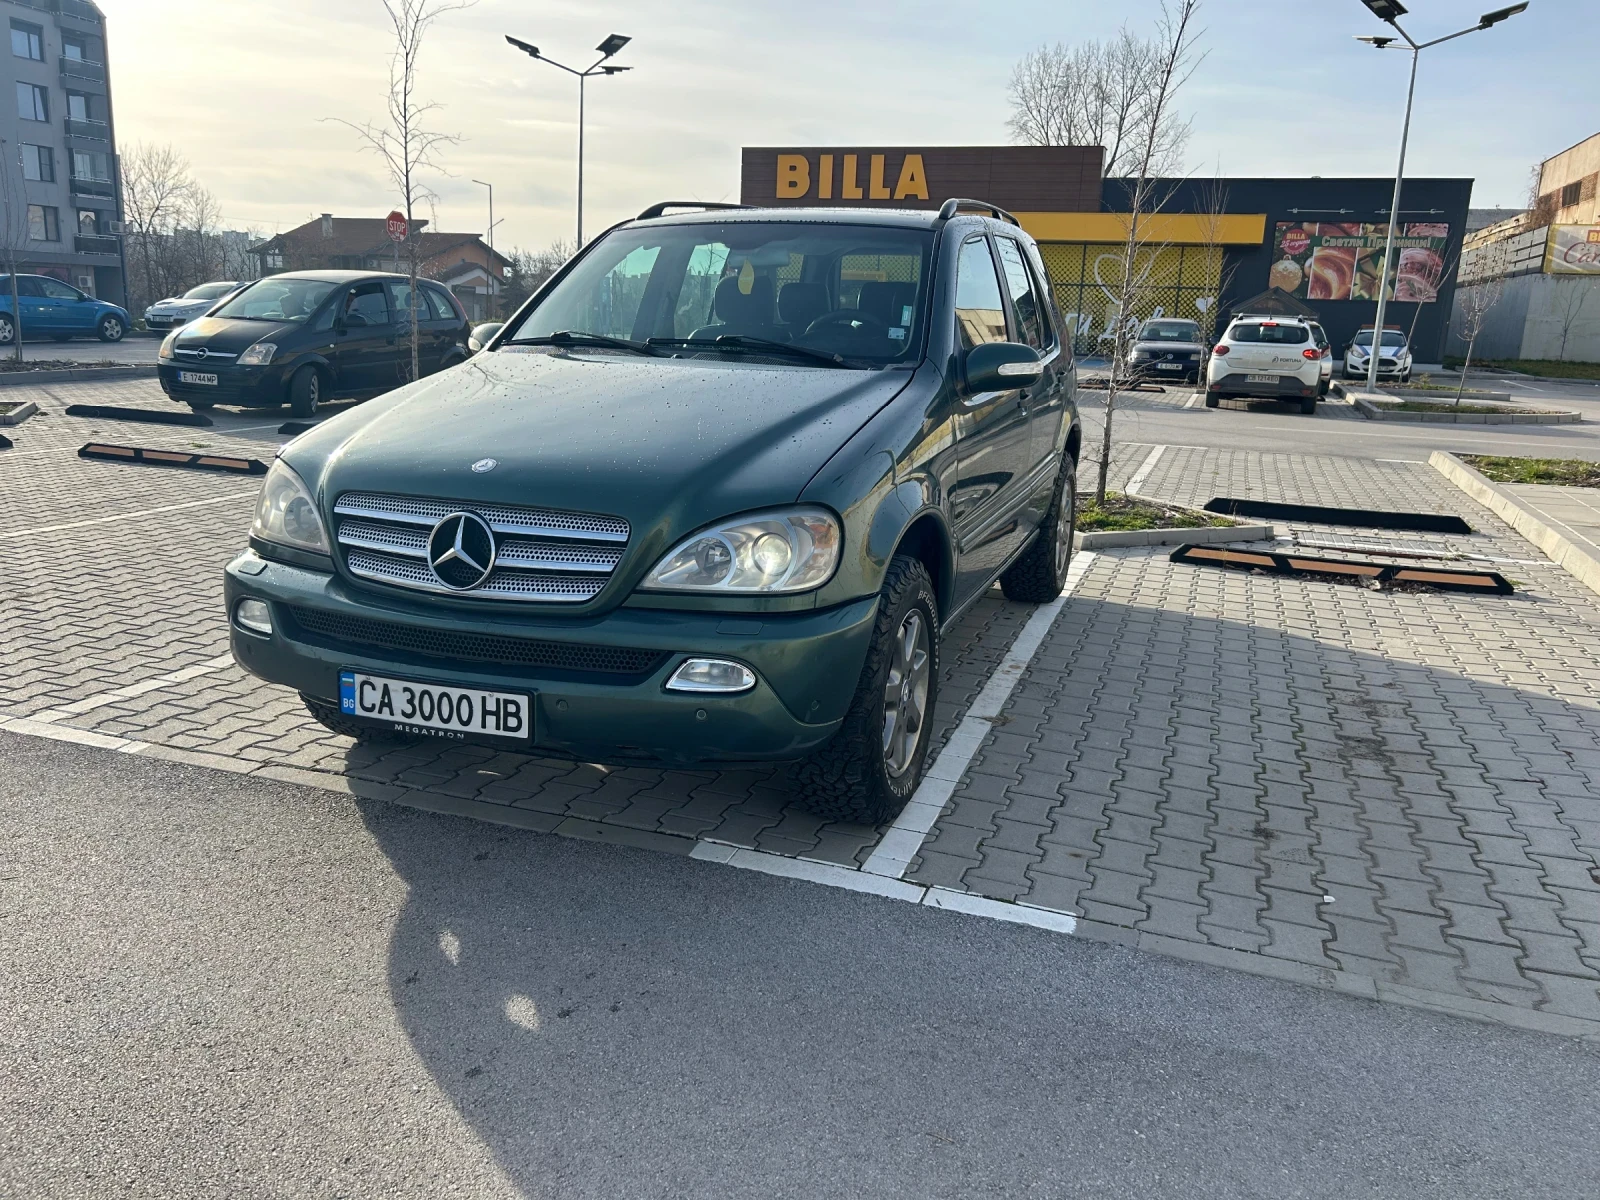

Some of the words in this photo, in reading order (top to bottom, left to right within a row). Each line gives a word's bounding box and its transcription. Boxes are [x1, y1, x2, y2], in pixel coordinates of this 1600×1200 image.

[776, 154, 929, 200] BILLA
[389, 220, 405, 233] STOP
[1321, 235, 1364, 247] Светли
[183, 373, 188, 381] E
[190, 373, 206, 382] 1744
[343, 697, 355, 709] BG
[359, 680, 395, 717] CA
[401, 686, 474, 727] 3000
[480, 695, 523, 733] HB
[394, 723, 465, 740] MEGATRON
